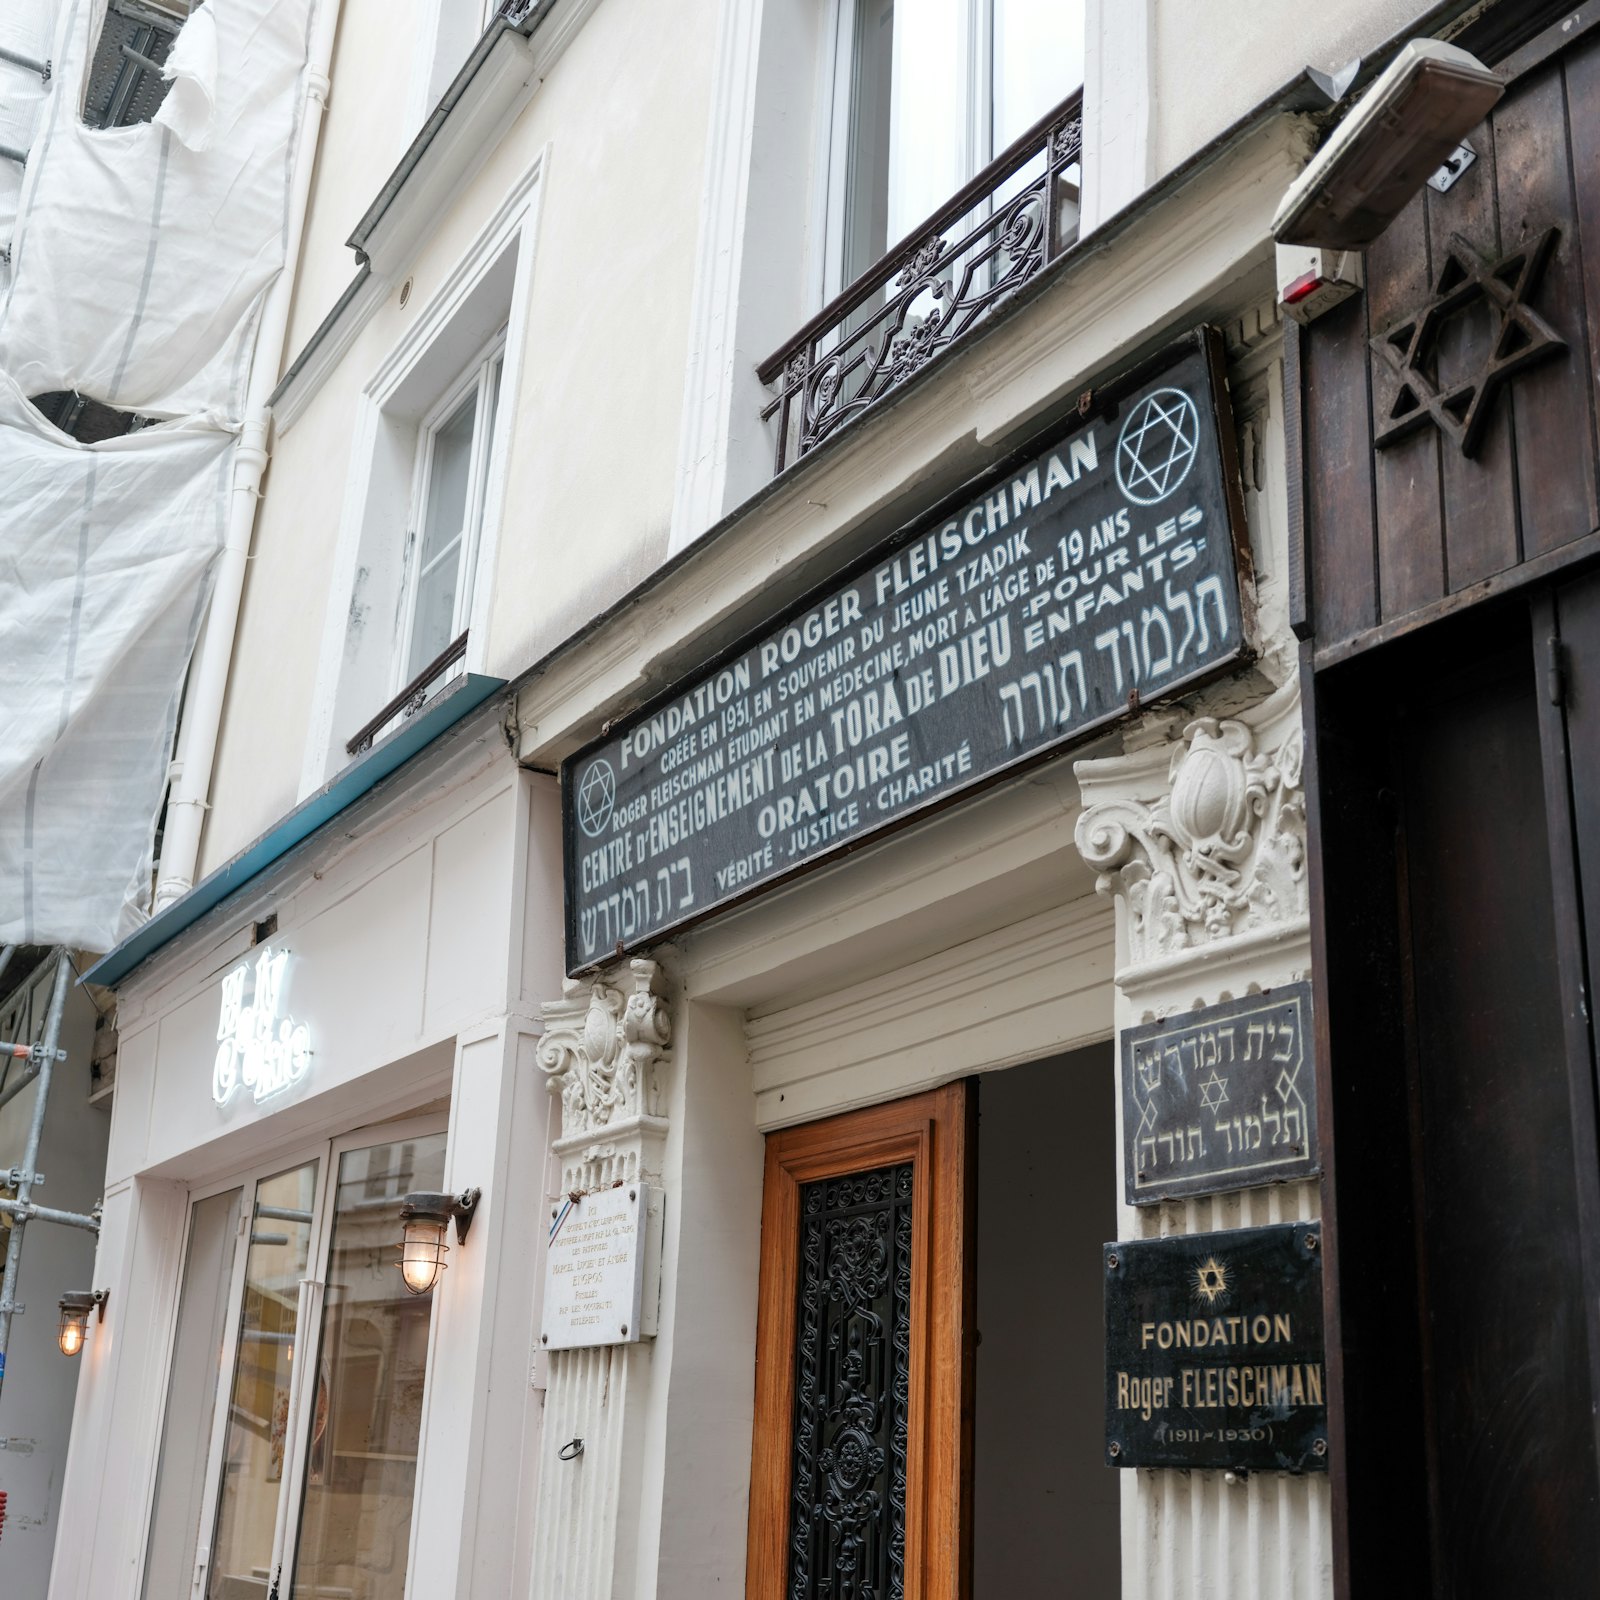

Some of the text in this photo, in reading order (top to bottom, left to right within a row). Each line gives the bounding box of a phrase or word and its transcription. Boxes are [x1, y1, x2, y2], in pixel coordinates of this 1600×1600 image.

[1137, 504, 1203, 557] LES
[621, 431, 1099, 771] FONDATION ROGER FLEISCHMAN
[701, 722, 718, 751] EN
[754, 685, 772, 718] EN
[778, 636, 856, 701] SOUVENIR
[861, 616, 884, 653] DU
[891, 576, 950, 633] JEUNE
[955, 527, 1032, 596] TZADIK
[612, 794, 648, 833] ROGER
[651, 748, 724, 811] FLEISCHMAN
[728, 708, 789, 766] ÉTUDIANT
[794, 691, 815, 727] EN
[908, 609, 958, 660] MORT
[963, 601, 977, 630] À
[980, 567, 1030, 619] L'ÂGE
[1035, 555, 1056, 588] DE
[1058, 529, 1084, 573] 19
[1089, 507, 1131, 557] ANS
[1000, 574, 1229, 751] תלמוד תורה
[582, 613, 1012, 894] CENTRE D'ENSEIGNEMENT DE LA TORA DE DIEU
[757, 731, 911, 839] ORATOIRE
[715, 738, 973, 891] VÉRITÉ JUSTICE CHARITÉ
[580, 856, 695, 957] בית המדרש
[1137, 1020, 1294, 1093] בית המדרש
[1140, 1092, 1301, 1169] תלמוד תורה
[1141, 1313, 1293, 1350] FONDATION
[1116, 1362, 1324, 1422] Roger FLEISCHMAN
